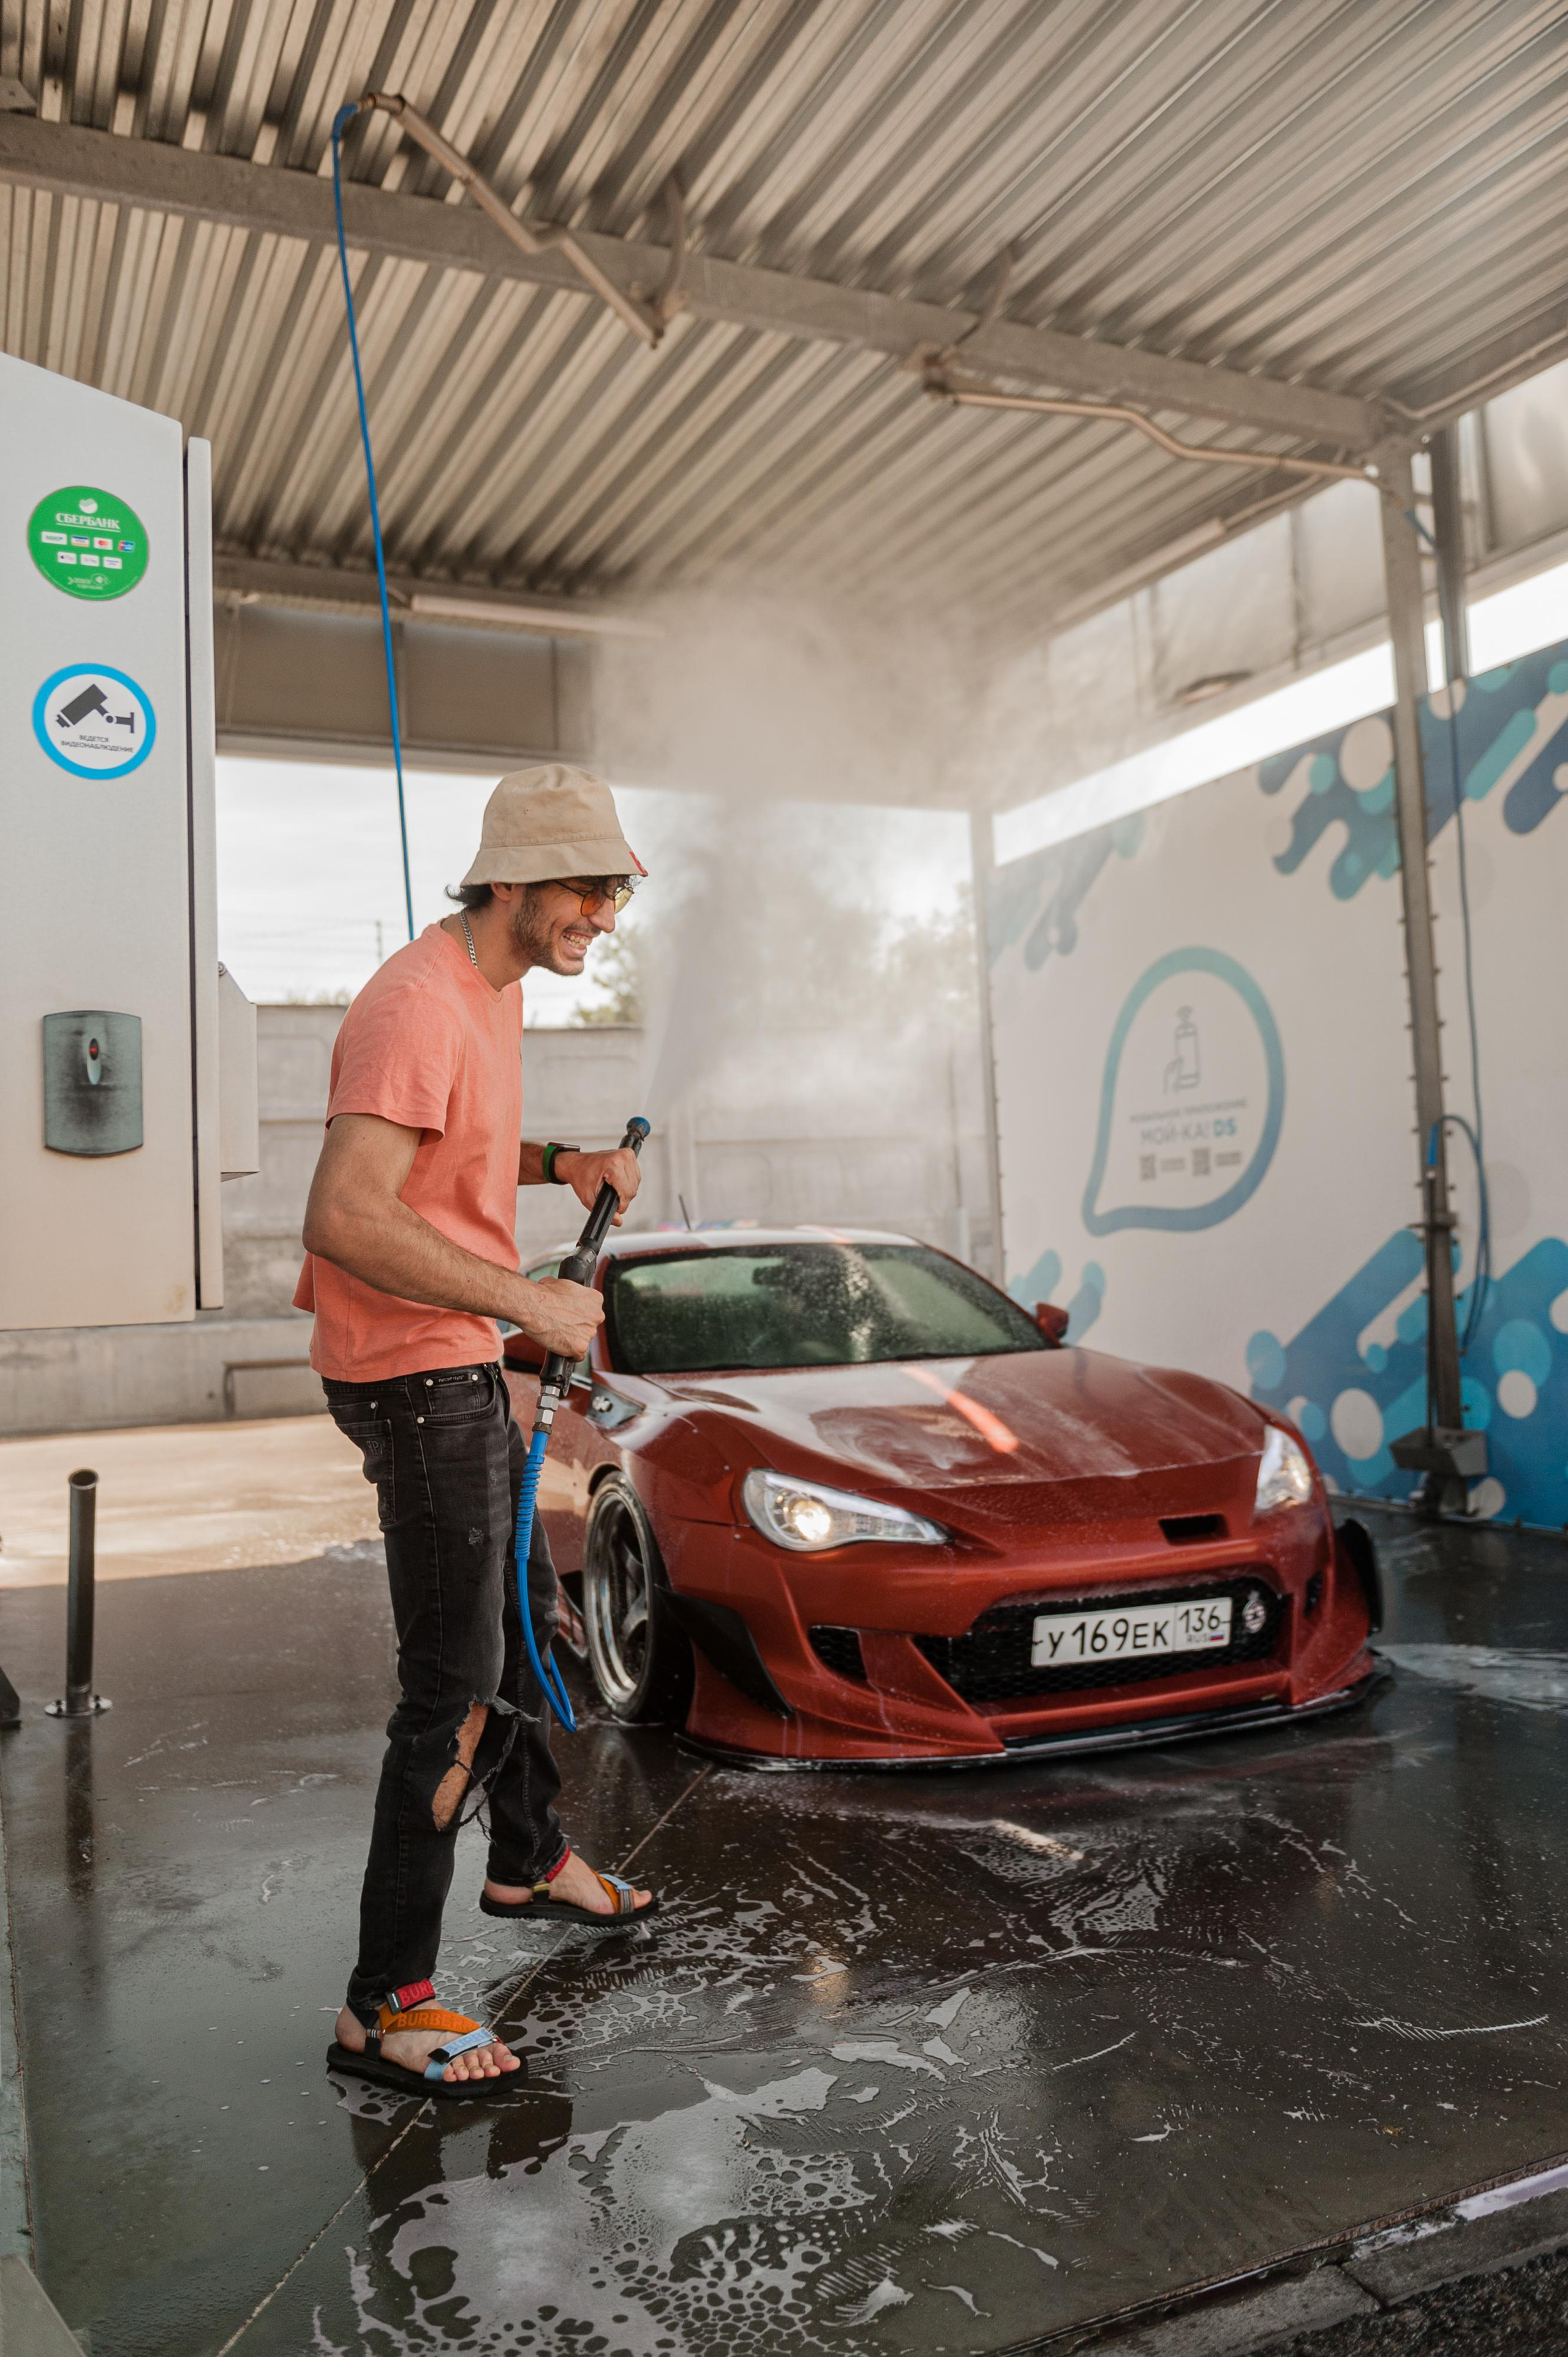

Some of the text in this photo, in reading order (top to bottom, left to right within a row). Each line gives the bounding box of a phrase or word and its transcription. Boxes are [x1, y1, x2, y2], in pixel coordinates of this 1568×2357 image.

[56, 512, 121, 530] СБЕРБАНК
[61, 740, 134, 753] ВИДЕОНАБЛЮДЕНИЕ
[79, 735, 109, 743] ВЕДЕТСЯ
[1213, 1117, 1237, 1137] DS
[1179, 1606, 1219, 1633] 136
[1187, 1633, 1208, 1644] RUS
